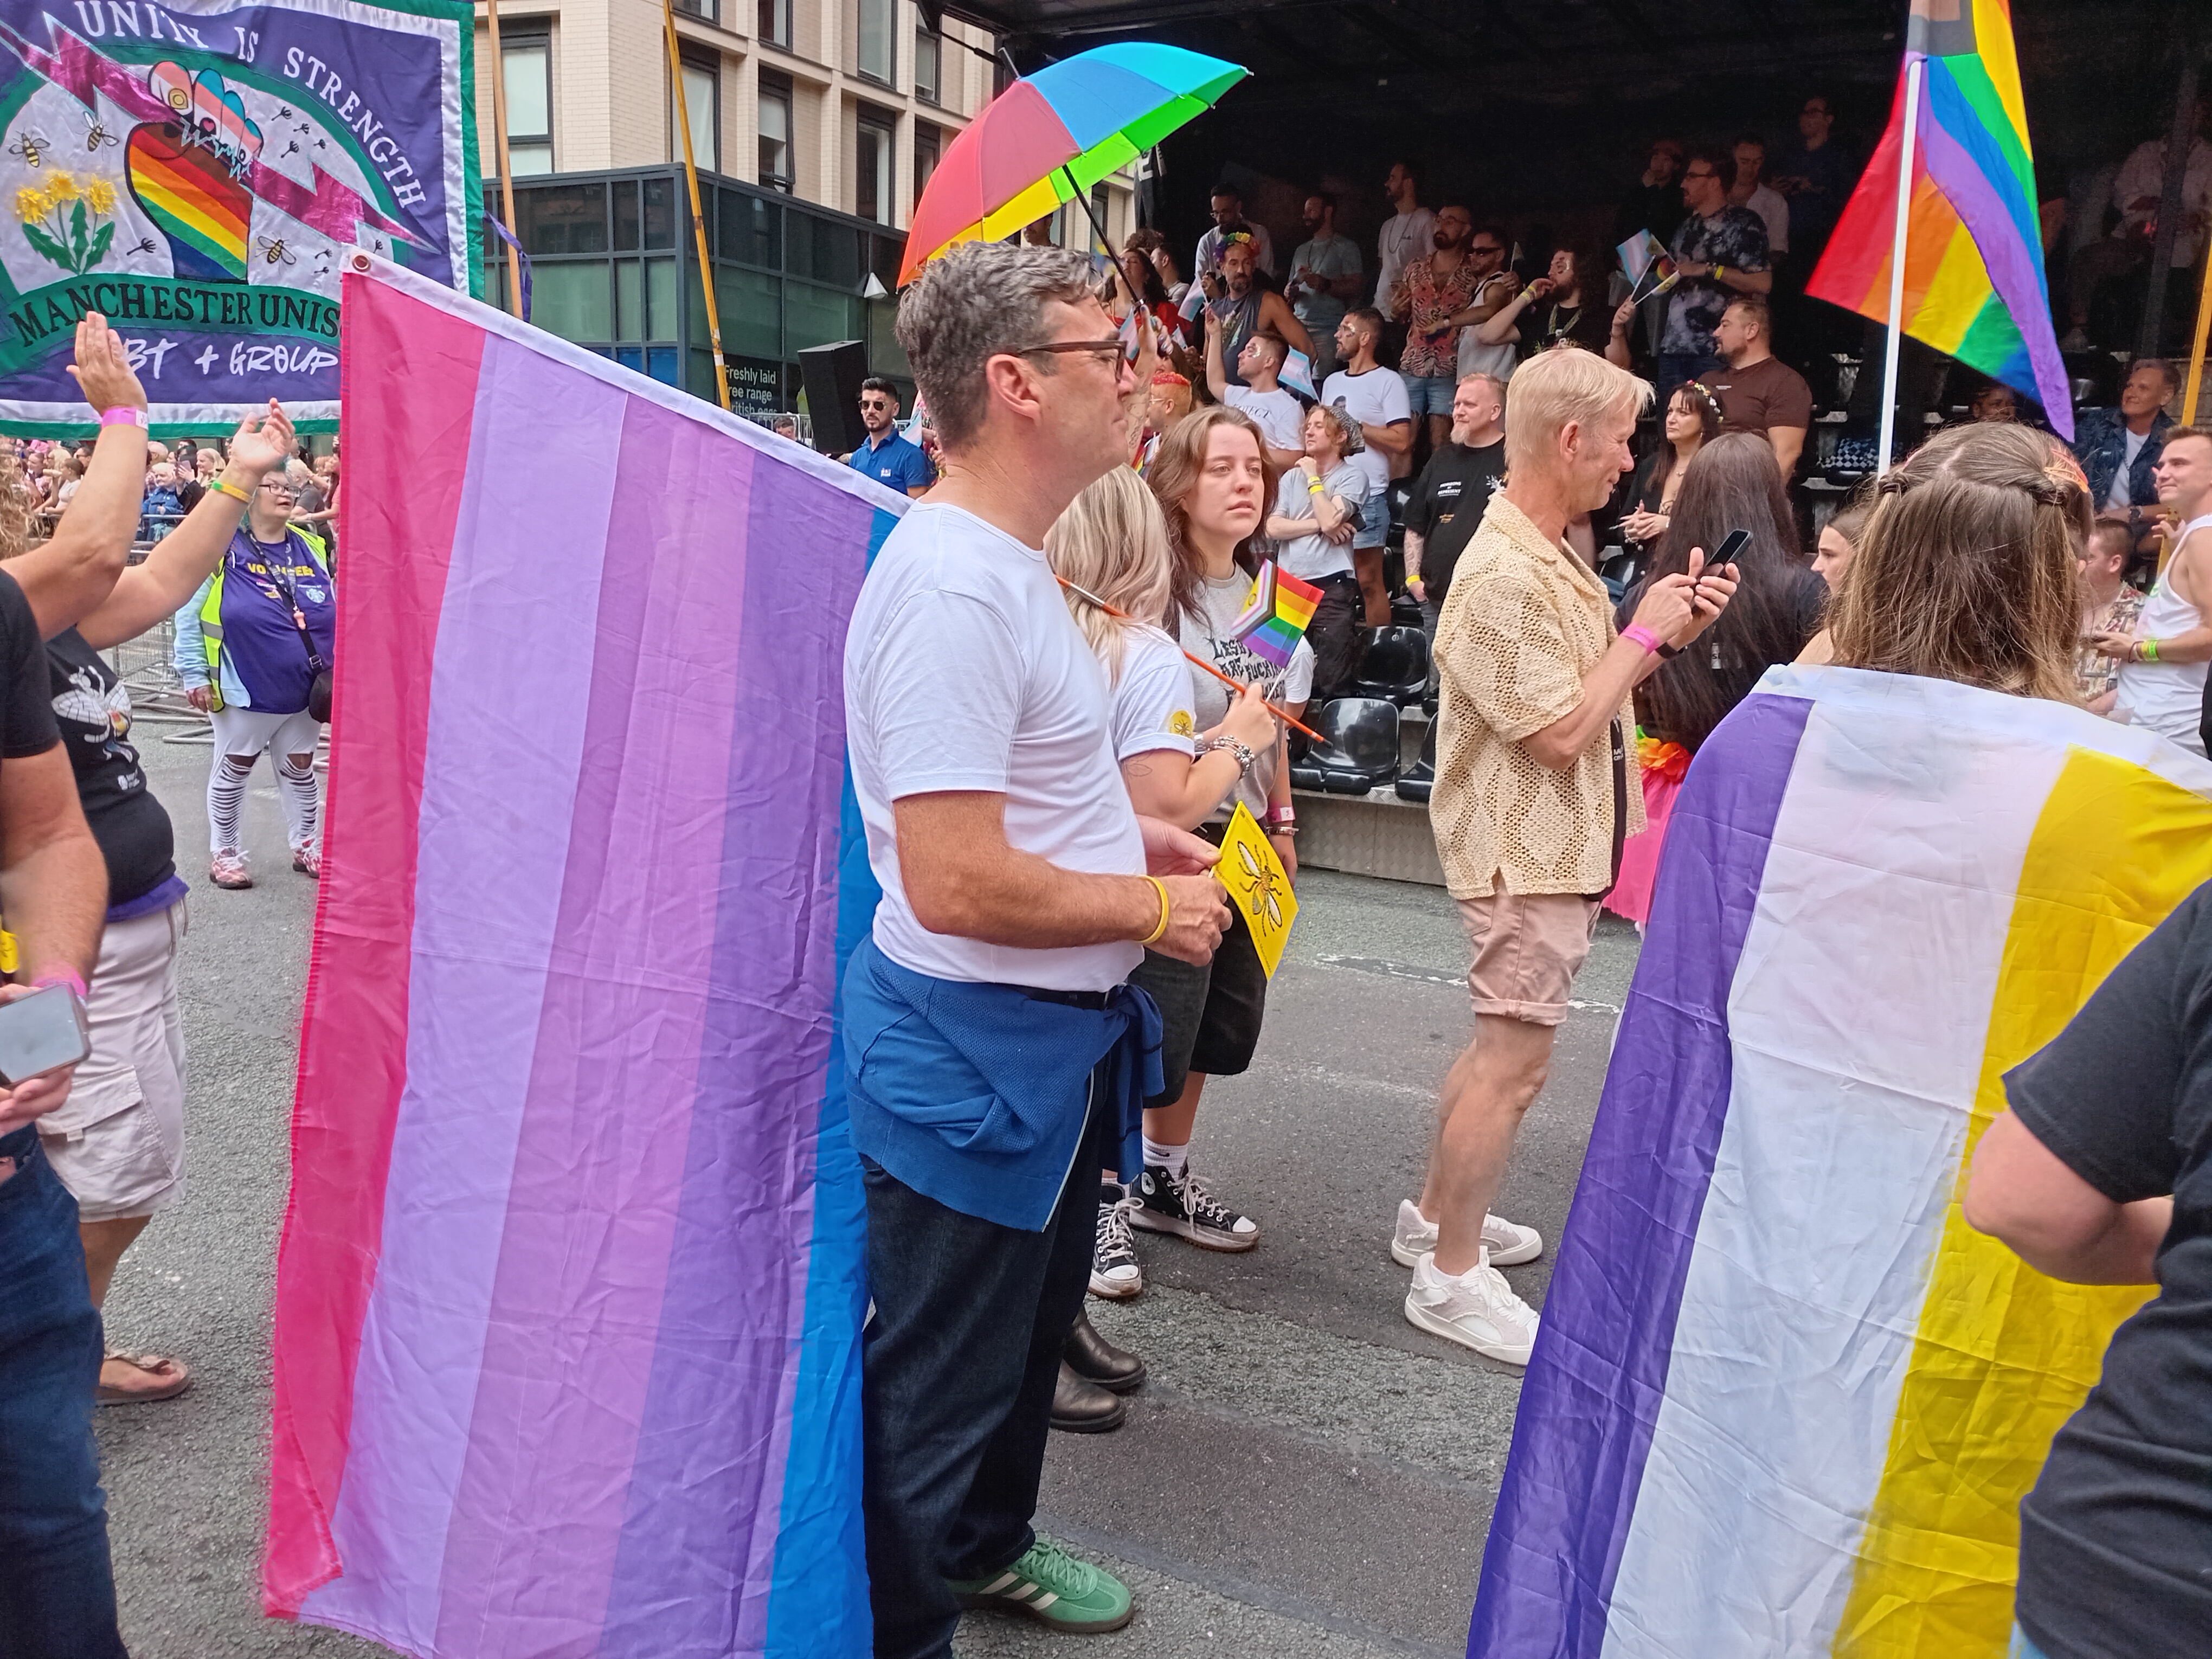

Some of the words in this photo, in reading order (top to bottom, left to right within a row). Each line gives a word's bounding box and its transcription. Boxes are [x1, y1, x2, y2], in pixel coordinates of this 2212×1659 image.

[234, 26, 259, 63] IS
[283, 47, 427, 209] STRENGTH
[8, 282, 254, 348] MANCHESTER
[259, 293, 343, 338] UNIS
[122, 337, 179, 380] BT
[229, 341, 339, 376] GROUP
[760, 369, 776, 384] laid
[728, 385, 744, 398] ree
[746, 388, 773, 404] range
[731, 401, 755, 416] ritish
[1233, 403, 1272, 419] OTECT
[1244, 660, 1282, 683] FUCKIN
